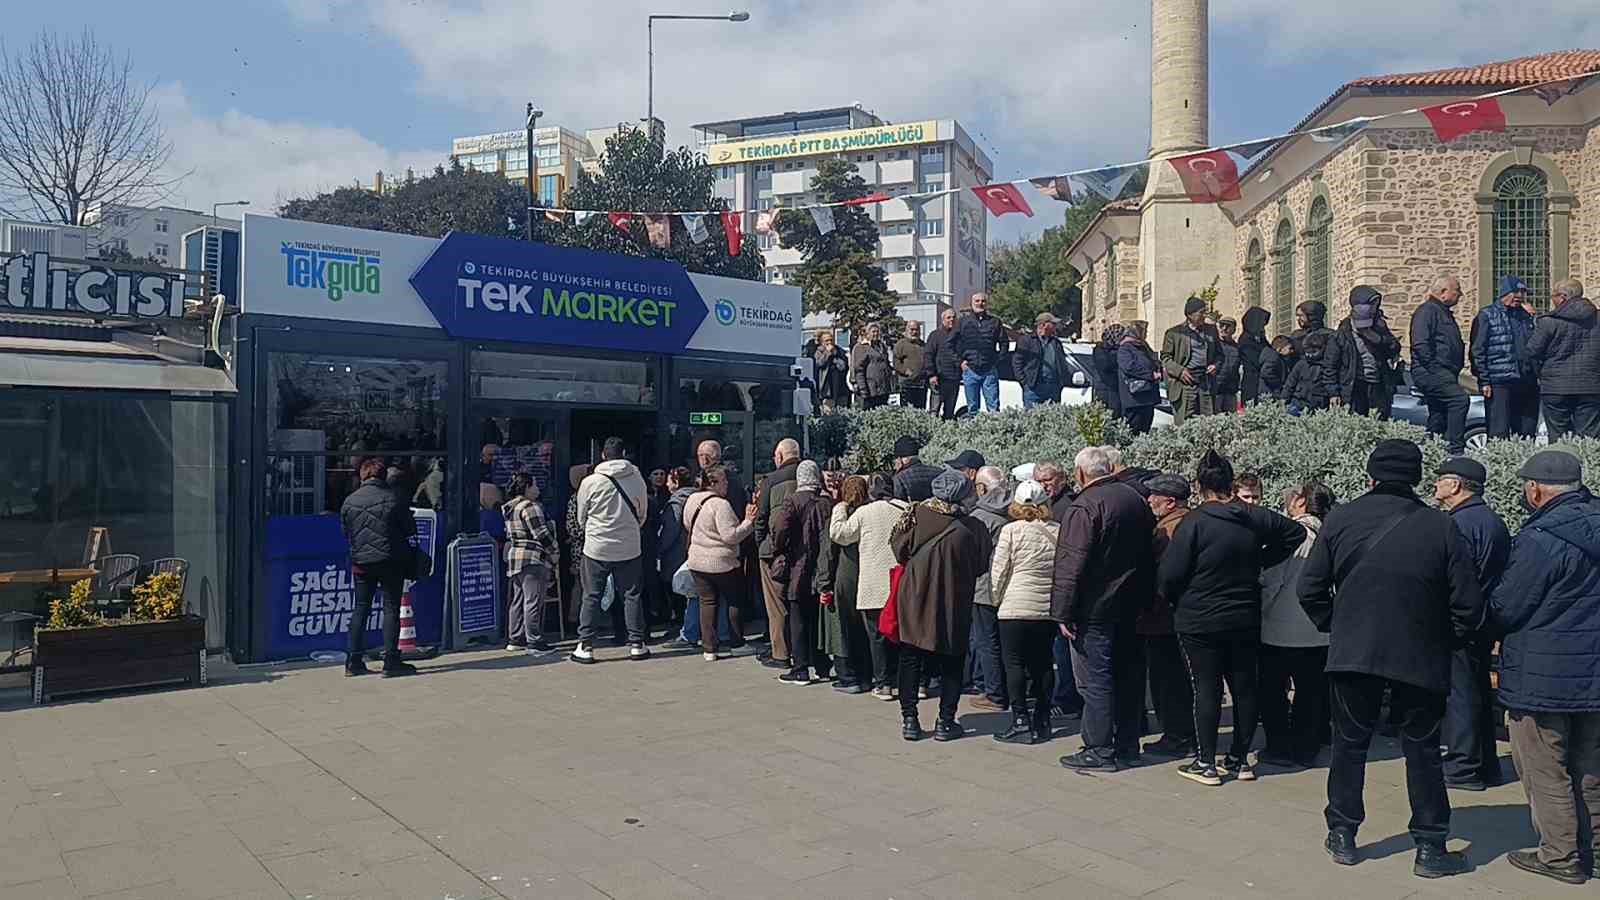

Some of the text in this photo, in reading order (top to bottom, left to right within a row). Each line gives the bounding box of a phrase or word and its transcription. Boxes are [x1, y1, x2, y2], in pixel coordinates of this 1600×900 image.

[740, 125, 923, 159] TEKİRDAĞ PTT BAŞMÜDÜRLÜĞÜ
[480, 264, 538, 280] TEKİRDAĞ
[740, 305, 793, 323] TEKİRDAĞ
